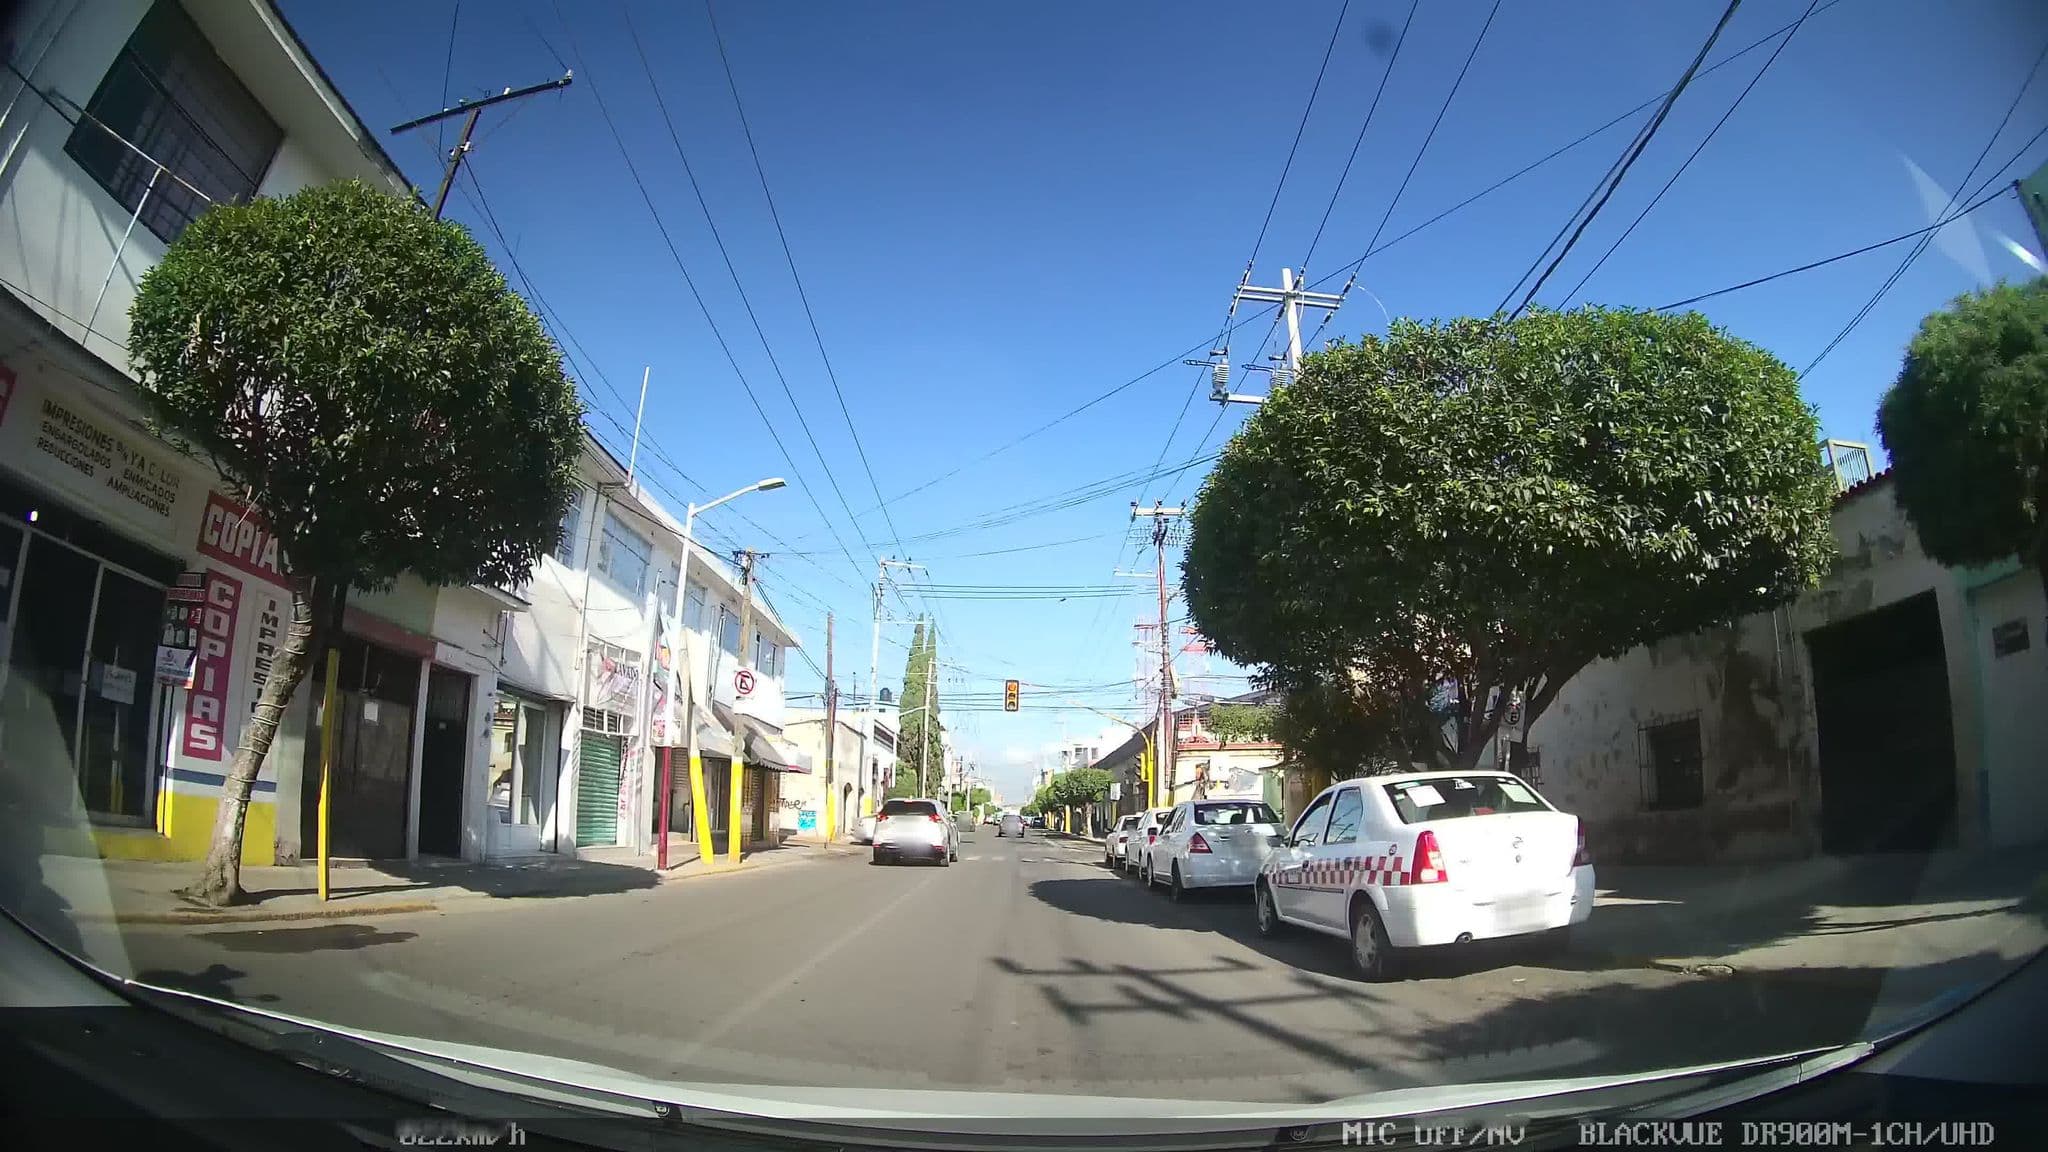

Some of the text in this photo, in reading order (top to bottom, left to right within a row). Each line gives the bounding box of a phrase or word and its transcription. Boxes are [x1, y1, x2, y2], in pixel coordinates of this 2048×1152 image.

[42, 421, 176, 504] ENGARGOLADOS ENMICADOS
[43, 398, 113, 452] IMPRESIONES
[36, 437, 171, 517] REDUCCIONES AMPLIACIONES
[190, 579, 235, 751] COPIAS
